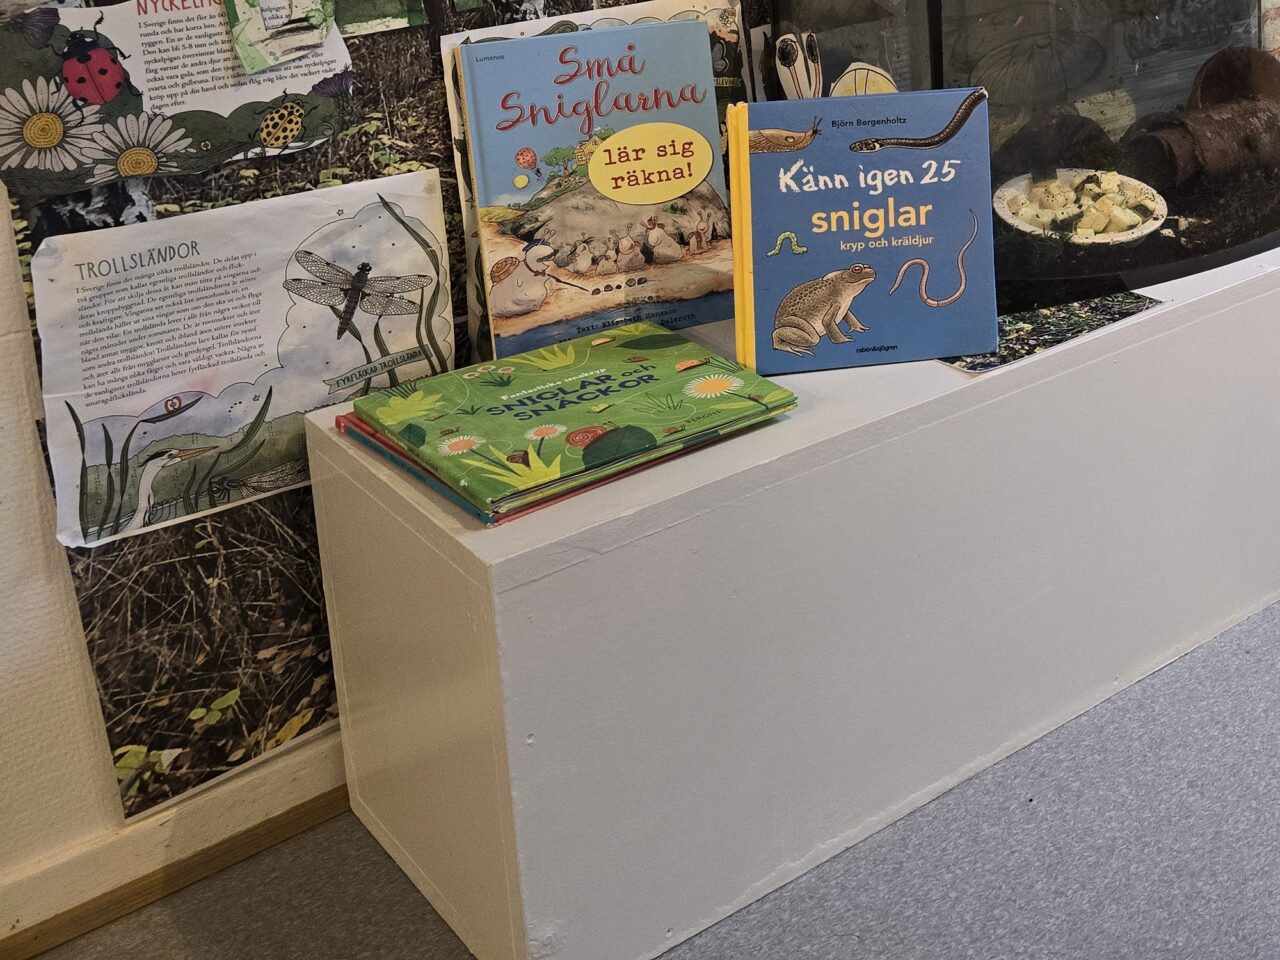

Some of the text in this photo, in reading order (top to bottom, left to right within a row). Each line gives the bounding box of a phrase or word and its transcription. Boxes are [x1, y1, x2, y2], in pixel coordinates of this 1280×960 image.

[144, 56, 180, 64] nyckelpigan
[475, 54, 505, 63] Lumenos
[553, 43, 646, 85] Små
[495, 80, 708, 136] Sniglarna
[831, 116, 907, 129] Björn Bergenholtz
[602, 139, 695, 166] lär sig
[611, 162, 693, 190] räkna!
[778, 158, 961, 195] Känn igen 25
[811, 197, 933, 238] sniglar
[74, 240, 200, 281] TROLLSLÄNDOR
[840, 235, 934, 253] kryp och kräldjur
[576, 324, 598, 334] Text:
[645, 308, 677, 319] Hansson
[336, 350, 422, 388] FYRFLÄCKAD TROLLSLÄNDA
[486, 364, 657, 415] SNIGLAR och
[513, 374, 660, 421] SNÄCKOR
